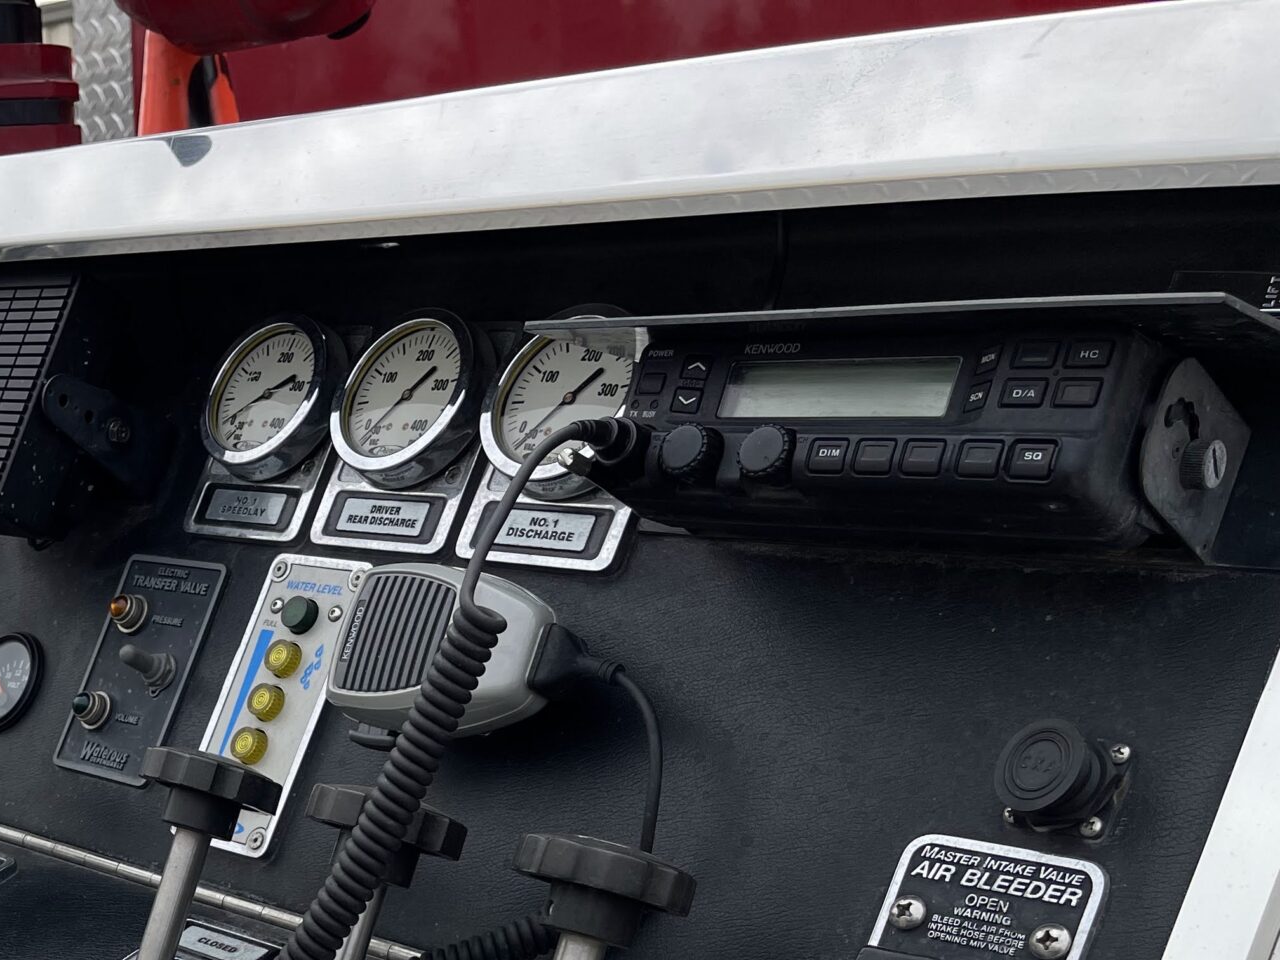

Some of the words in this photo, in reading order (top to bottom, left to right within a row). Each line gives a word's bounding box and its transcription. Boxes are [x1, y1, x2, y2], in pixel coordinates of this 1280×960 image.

[581, 348, 603, 363] 200
[744, 343, 801, 354] KENWOOD
[1080, 350, 1099, 359] HC
[277, 352, 294, 363] 200
[416, 350, 435, 362] 200
[381, 371, 398, 383] 100
[540, 370, 560, 383] 100
[431, 379, 450, 391] 300
[597, 383, 619, 397] 300
[1012, 389, 1035, 398] D/A
[411, 419, 428, 432] 400
[819, 448, 840, 457] DIM
[1024, 452, 1042, 461] SQ
[220, 505, 266, 517] SPEEDLAY
[370, 504, 402, 516] DRIVER
[346, 514, 369, 525] REAR
[369, 516, 418, 529] DISCHARGE
[529, 517, 549, 528] NO.
[552, 519, 559, 529] 1
[505, 527, 575, 542] DISCHARGE
[158, 567, 189, 578] ELECTRIC
[133, 575, 177, 591] TRANSFER
[180, 581, 209, 595] VALVE
[287, 580, 316, 593] WATER
[318, 585, 343, 595] LEVEL
[342, 607, 364, 659] KENWOOD
[80, 741, 129, 763] Waterous
[921, 845, 981, 866] MASTER
[983, 857, 1036, 877] INTAKE
[1039, 867, 1085, 886] VALVE
[911, 860, 956, 882] AIR
[960, 869, 1083, 907] BLEEDER
[965, 893, 1010, 913] OPEN
[953, 907, 1012, 926] WARNING
[932, 914, 961, 926] BLEED
[962, 920, 979, 930] ALL
[980, 924, 997, 934] AIR
[998, 928, 1026, 940] FROM
[927, 922, 958, 935] INTAKE
[959, 928, 984, 941] HOSE
[986, 934, 1025, 949] BEFORE
[198, 937, 238, 953] CLOSED
[927, 930, 967, 946] OPENING
[969, 939, 986, 949] MIV
[987, 943, 1016, 957] VALVE
